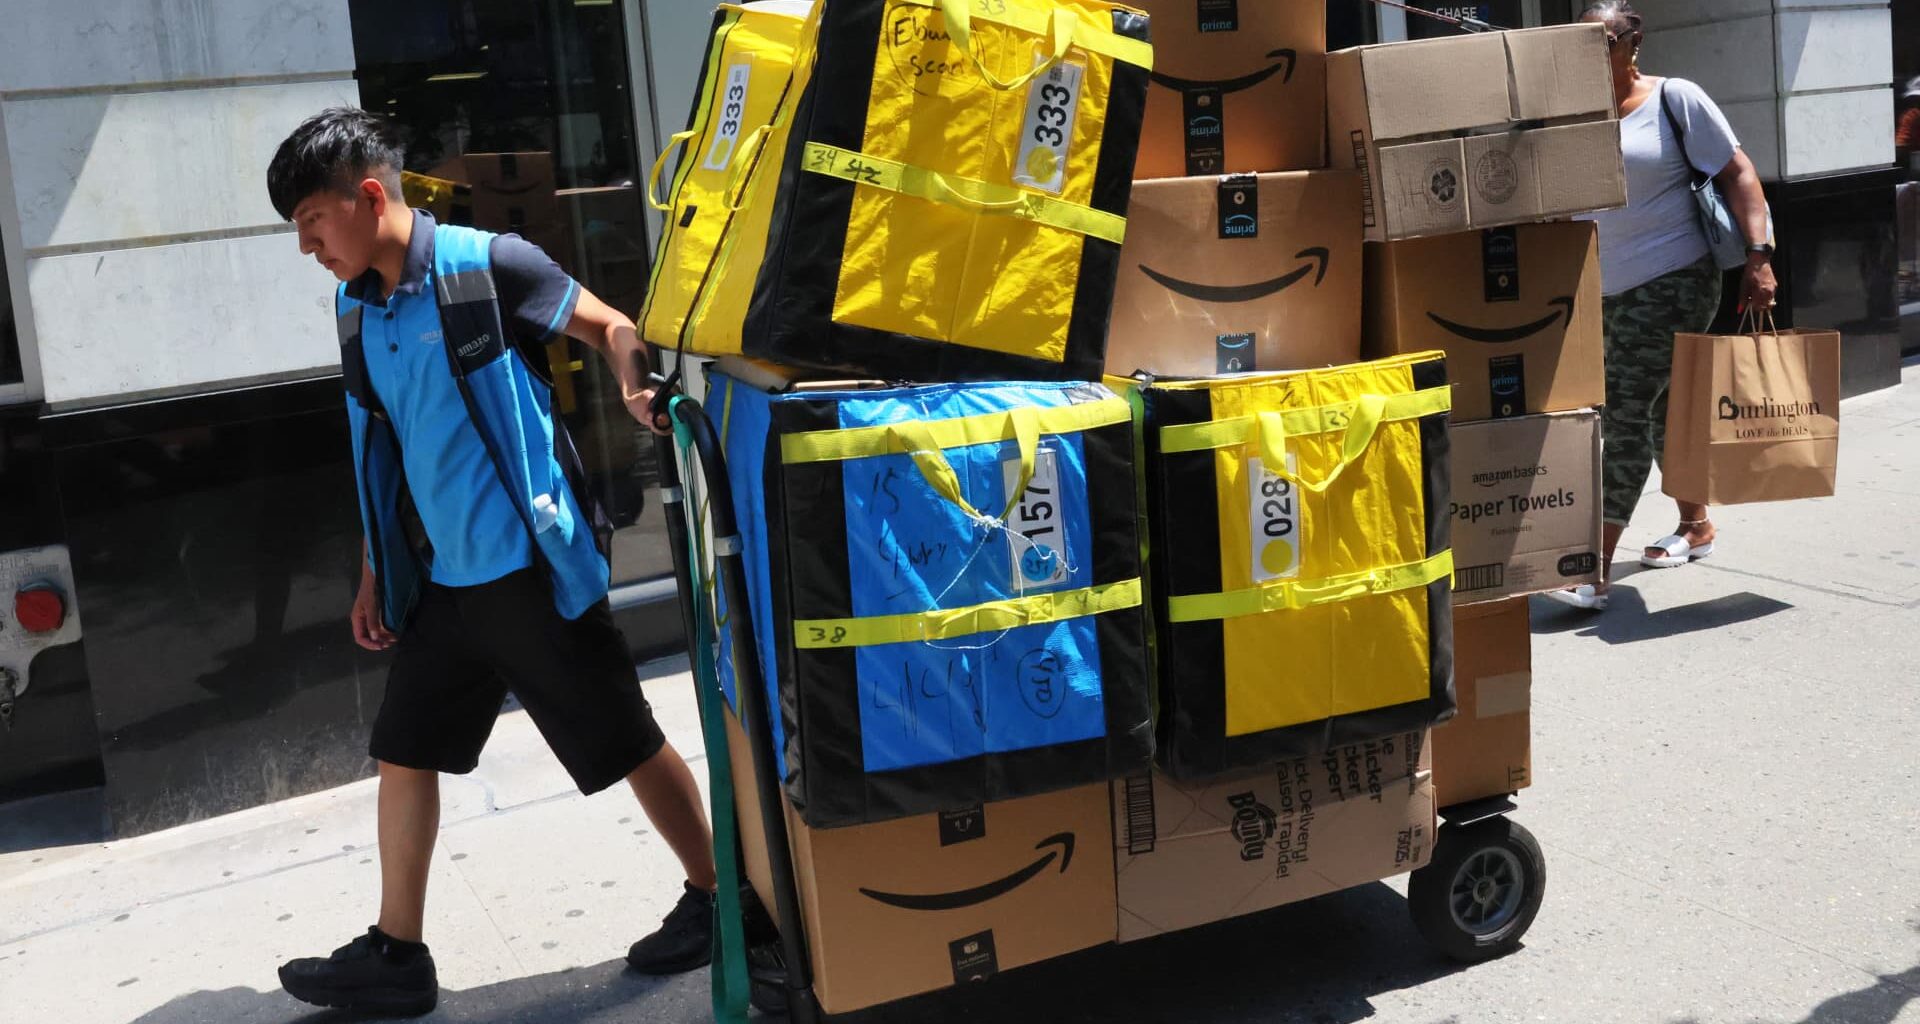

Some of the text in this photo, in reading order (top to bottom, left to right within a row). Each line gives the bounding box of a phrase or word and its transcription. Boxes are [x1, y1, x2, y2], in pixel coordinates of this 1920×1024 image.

[1201, 20, 1233, 32] prime
[1436, 7, 1478, 19] CHASE
[722, 85, 744, 136] 333
[1034, 83, 1070, 147] 333
[1190, 123, 1220, 136] prime
[811, 150, 837, 172] 34
[1225, 222, 1256, 236] prime
[457, 333, 490, 357] amazo
[1718, 395, 1820, 423] Burlington
[1736, 425, 1808, 439] LOVE the DEALS
[1020, 485, 1054, 541] 157
[1261, 478, 1293, 537] 028
[1449, 487, 1575, 523] Paper Towels
[1581, 555, 1592, 567] 12
[808, 626, 847, 643] 38
[1344, 746, 1361, 794] cker
[1365, 742, 1382, 804] icker
[1227, 790, 1265, 862] Bounty
[1275, 760, 1296, 881] raison rapide!
[1292, 789, 1315, 863] Delivery!
